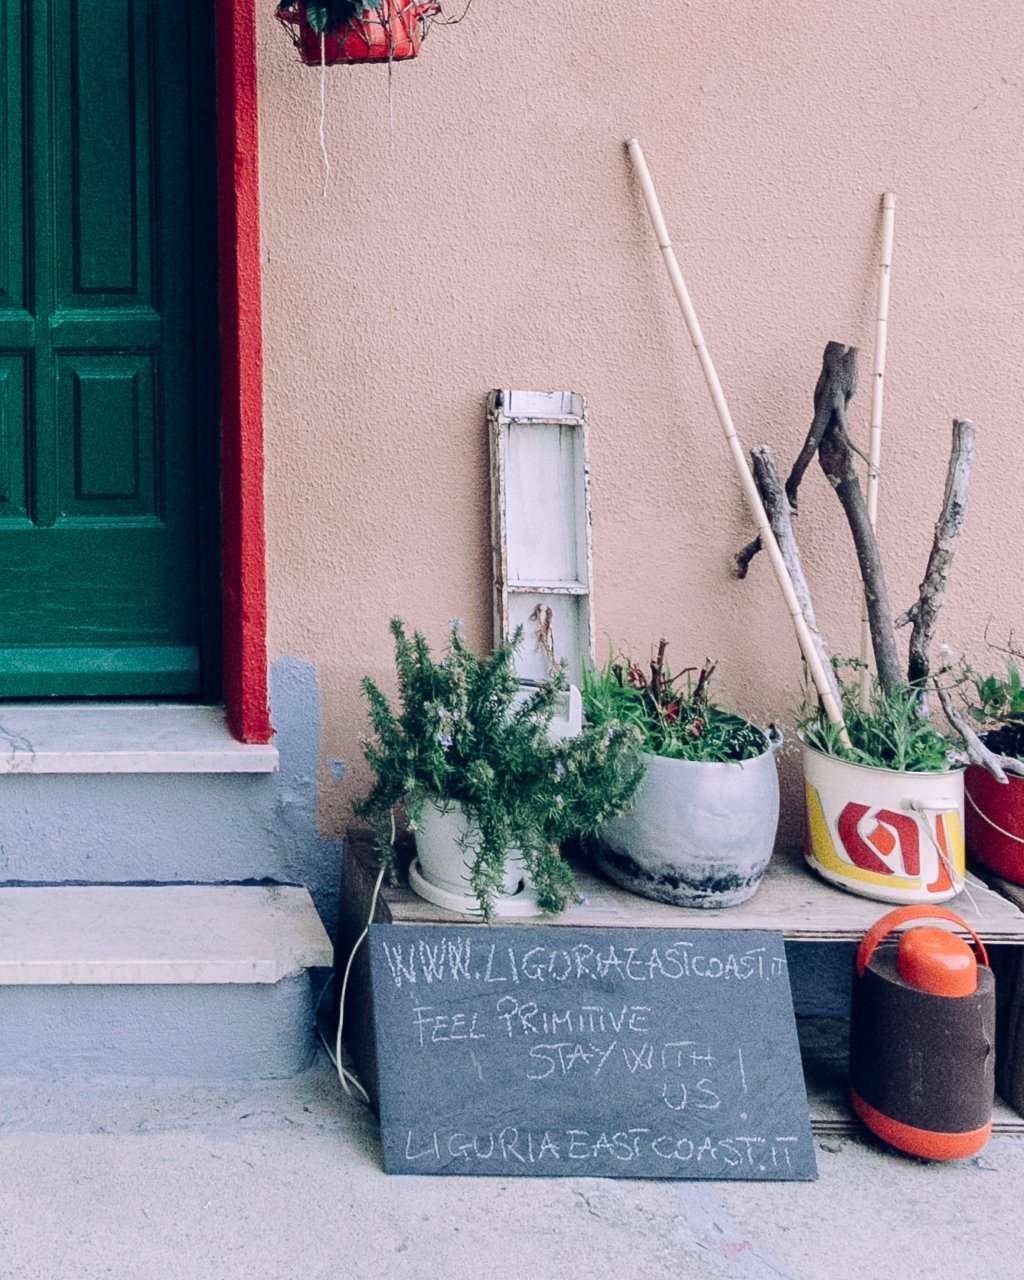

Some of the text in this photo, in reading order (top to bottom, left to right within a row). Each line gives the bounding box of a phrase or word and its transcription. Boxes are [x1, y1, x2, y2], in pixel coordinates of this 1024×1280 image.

[412, 995, 652, 1048] FEEL PRIMITIVE
[526, 1041, 717, 1080] STAY WITH
